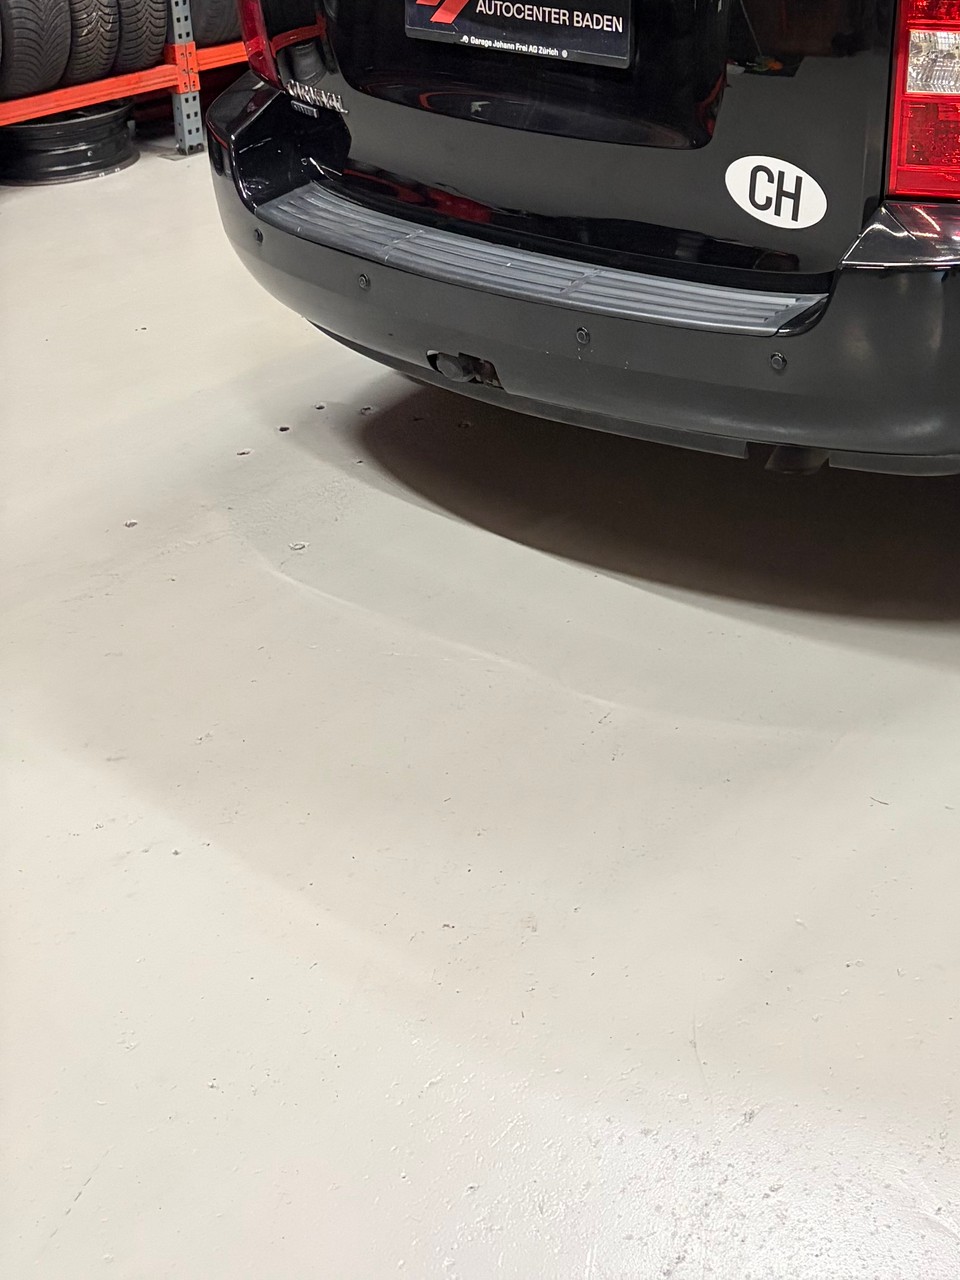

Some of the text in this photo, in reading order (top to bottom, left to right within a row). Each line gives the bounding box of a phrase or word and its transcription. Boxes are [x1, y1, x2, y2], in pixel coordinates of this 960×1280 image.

[573, 10, 623, 33] BADEN
[470, 36, 559, 56] Garage Johann Frei AG Zürich
[748, 165, 803, 222] CH
